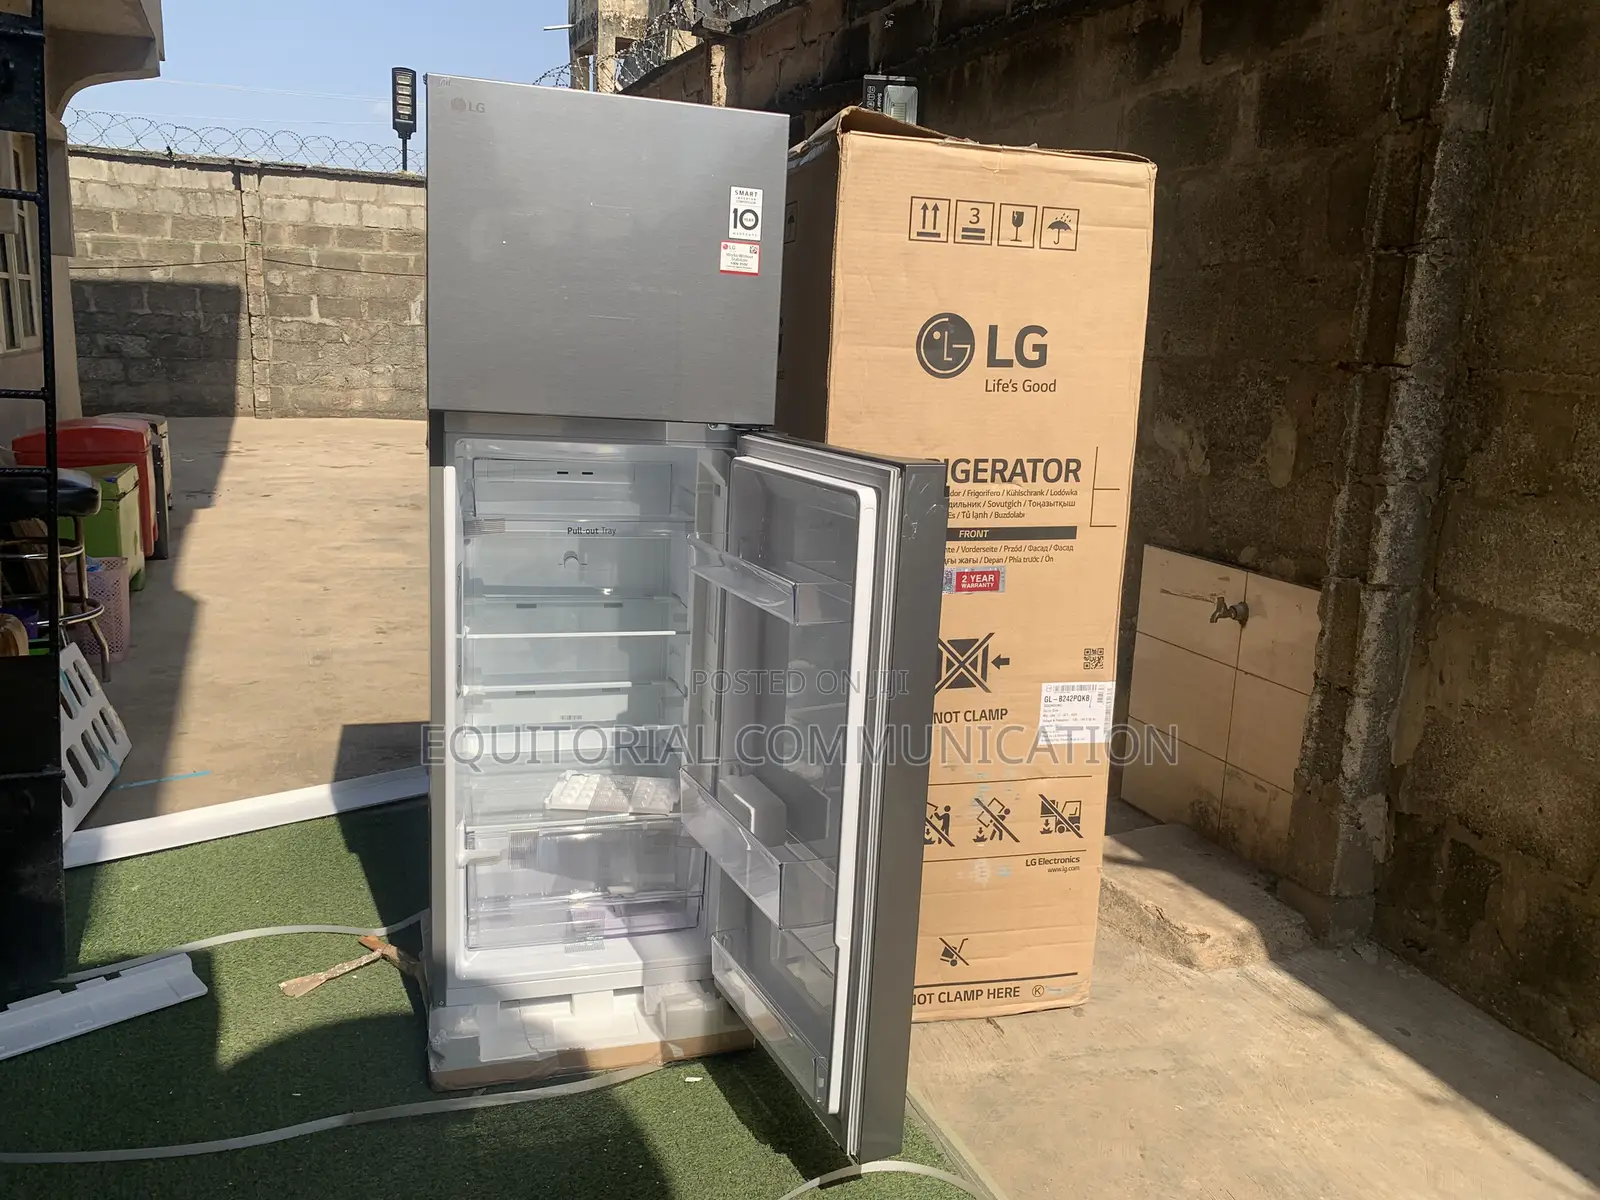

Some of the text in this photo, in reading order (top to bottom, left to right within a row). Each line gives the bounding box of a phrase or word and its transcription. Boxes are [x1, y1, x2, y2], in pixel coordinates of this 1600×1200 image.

[468, 102, 485, 113] LG
[733, 208, 759, 230] 10
[968, 207, 981, 225] 3
[986, 324, 1049, 369] LG
[985, 378, 1057, 393] Life's Good
[925, 457, 1082, 484] IGERATOR
[967, 489, 1001, 499] Frigorifero
[1006, 489, 1044, 497] Kühlschrank
[1050, 488, 1078, 496] Lodówka
[987, 499, 1022, 509] Sovutgich
[567, 526, 617, 536] Pull-out Tray
[958, 529, 990, 538] FRONT
[961, 545, 998, 554] Vorderseite
[983, 556, 1004, 565] Depan
[961, 574, 968, 583] 2
[970, 574, 995, 583] YEAR
[933, 708, 1009, 724] NOT CLAMP
[1025, 856, 1081, 867] LG Electronics
[1047, 865, 1081, 873] www.lg.com
[938, 989, 984, 1004] CLAMP
[987, 986, 1020, 1000] HERE
